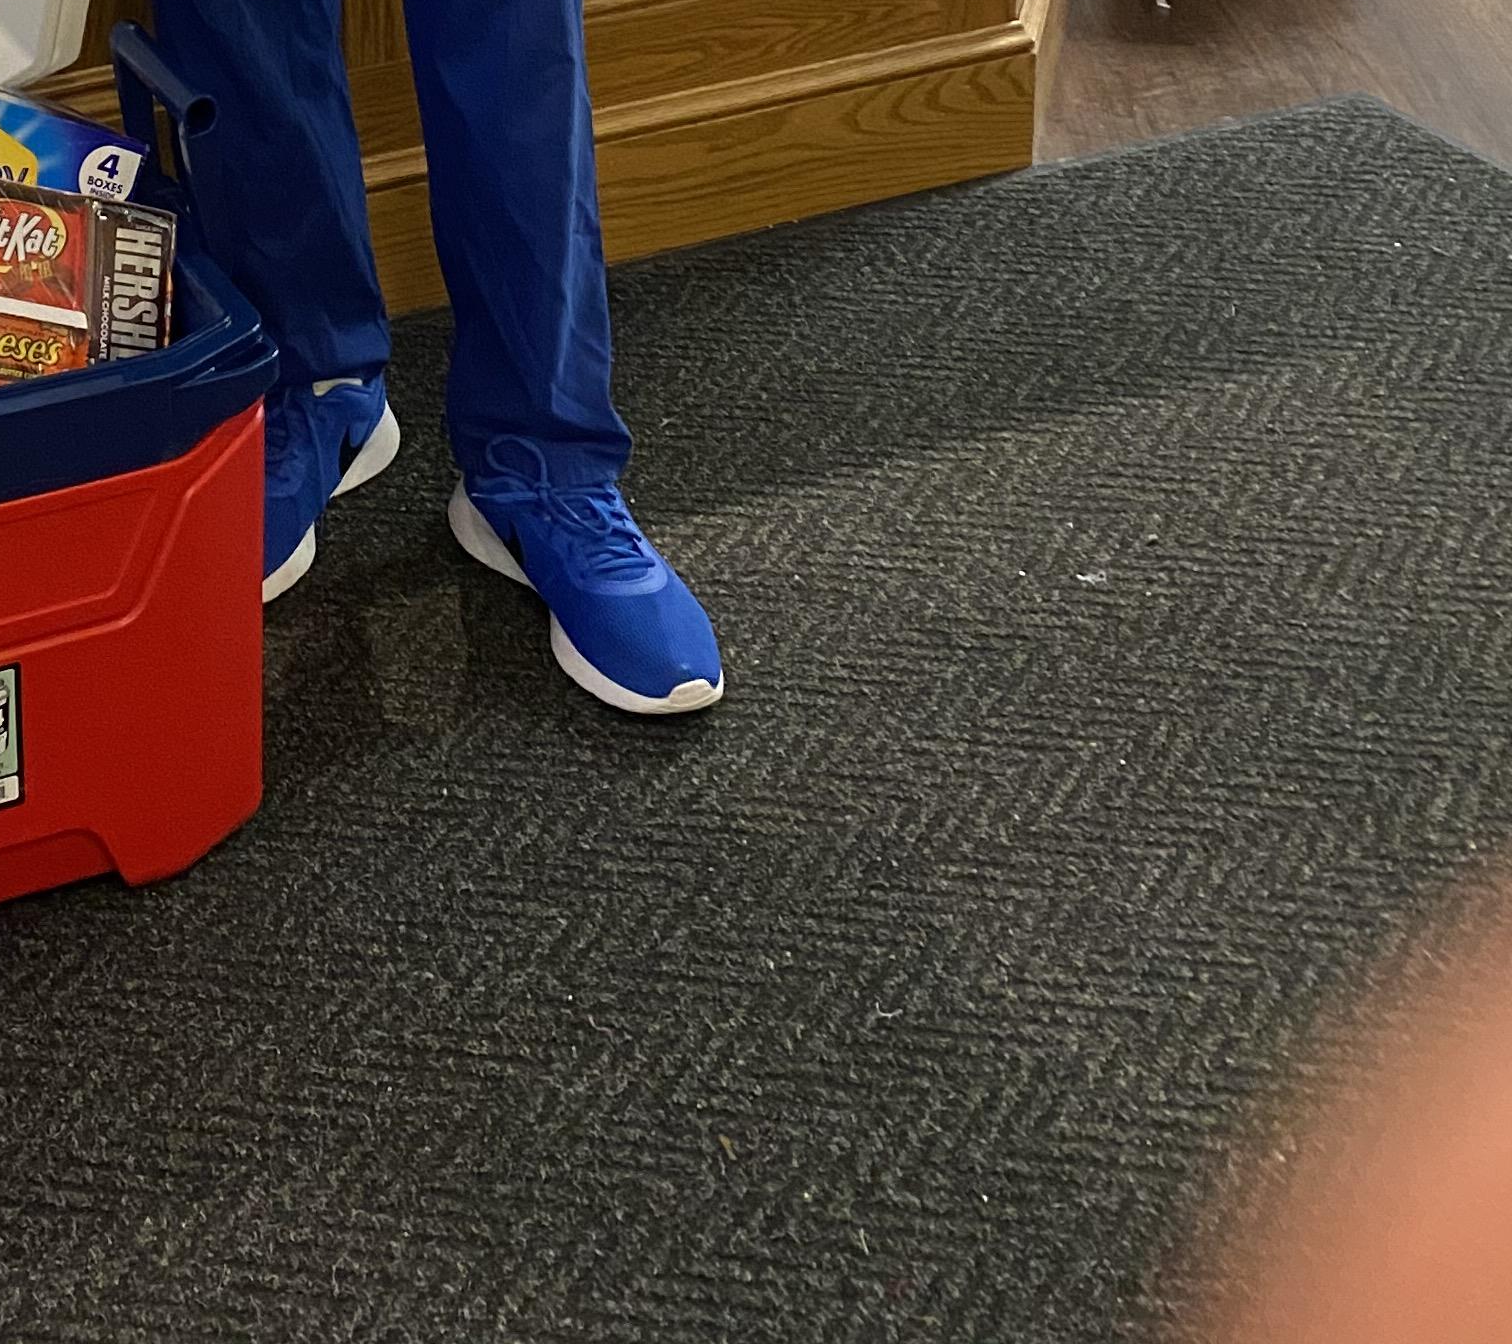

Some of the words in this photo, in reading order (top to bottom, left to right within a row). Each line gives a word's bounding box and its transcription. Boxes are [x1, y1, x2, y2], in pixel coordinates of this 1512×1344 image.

[96, 153, 121, 180] 4
[86, 174, 124, 195] BOXES
[102, 275, 111, 299] MILK
[98, 299, 111, 360] CHOCOLATE
